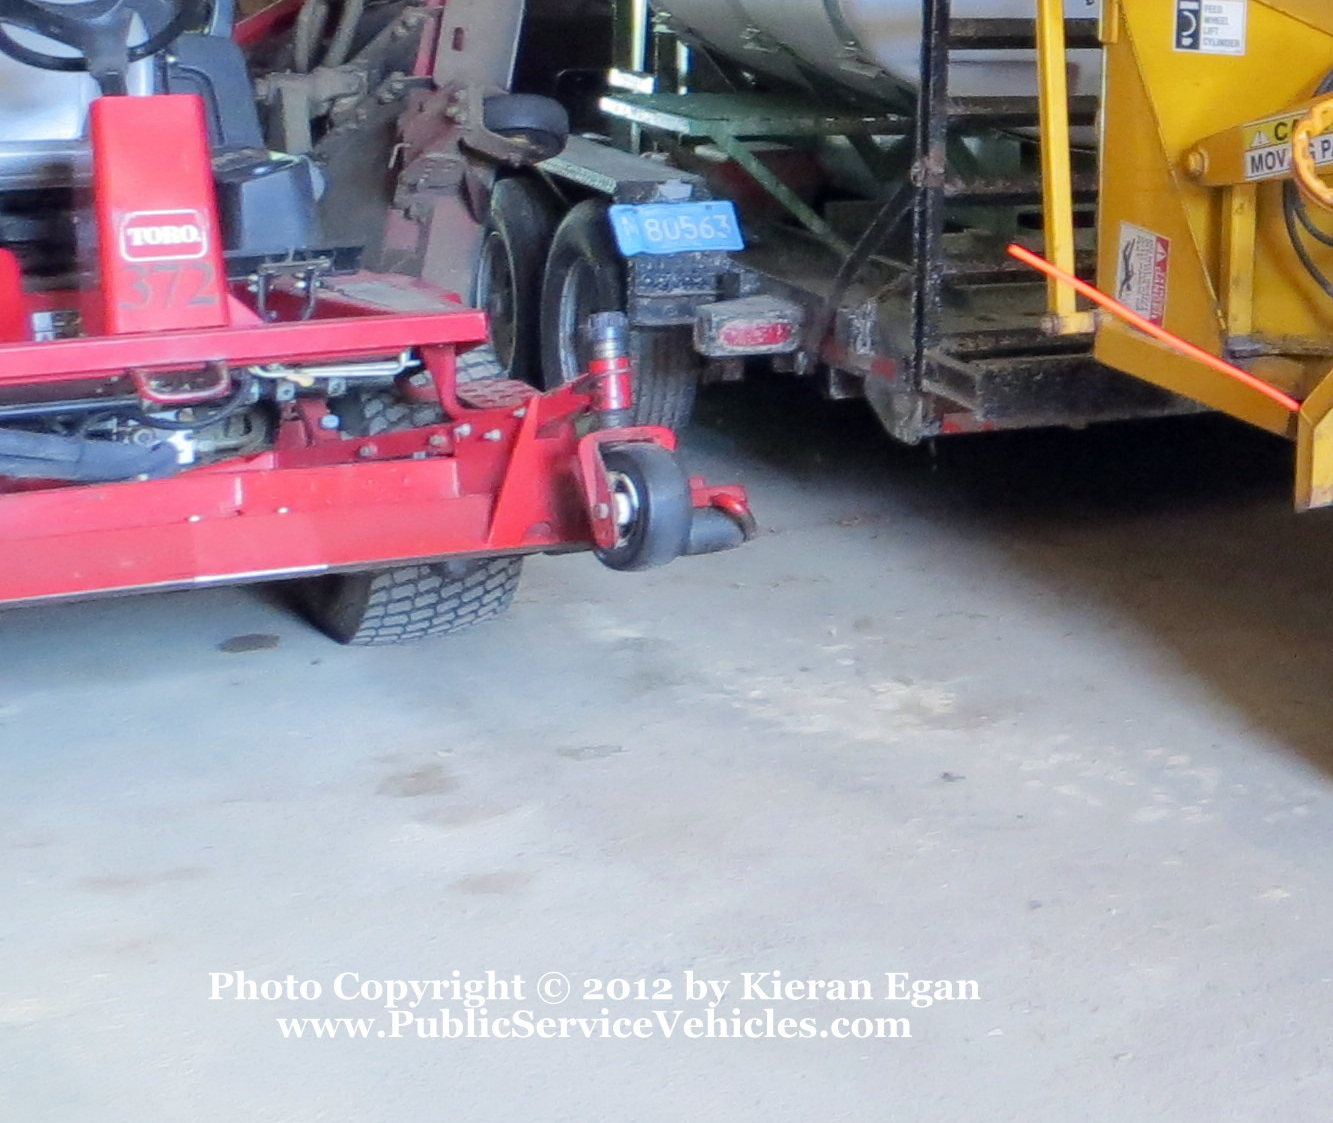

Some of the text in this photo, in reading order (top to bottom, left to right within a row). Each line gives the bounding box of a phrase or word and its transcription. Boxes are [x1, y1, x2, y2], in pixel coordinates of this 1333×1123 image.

[127, 224, 200, 246] TORO
[644, 214, 733, 242] 80563
[119, 261, 219, 310] 372
